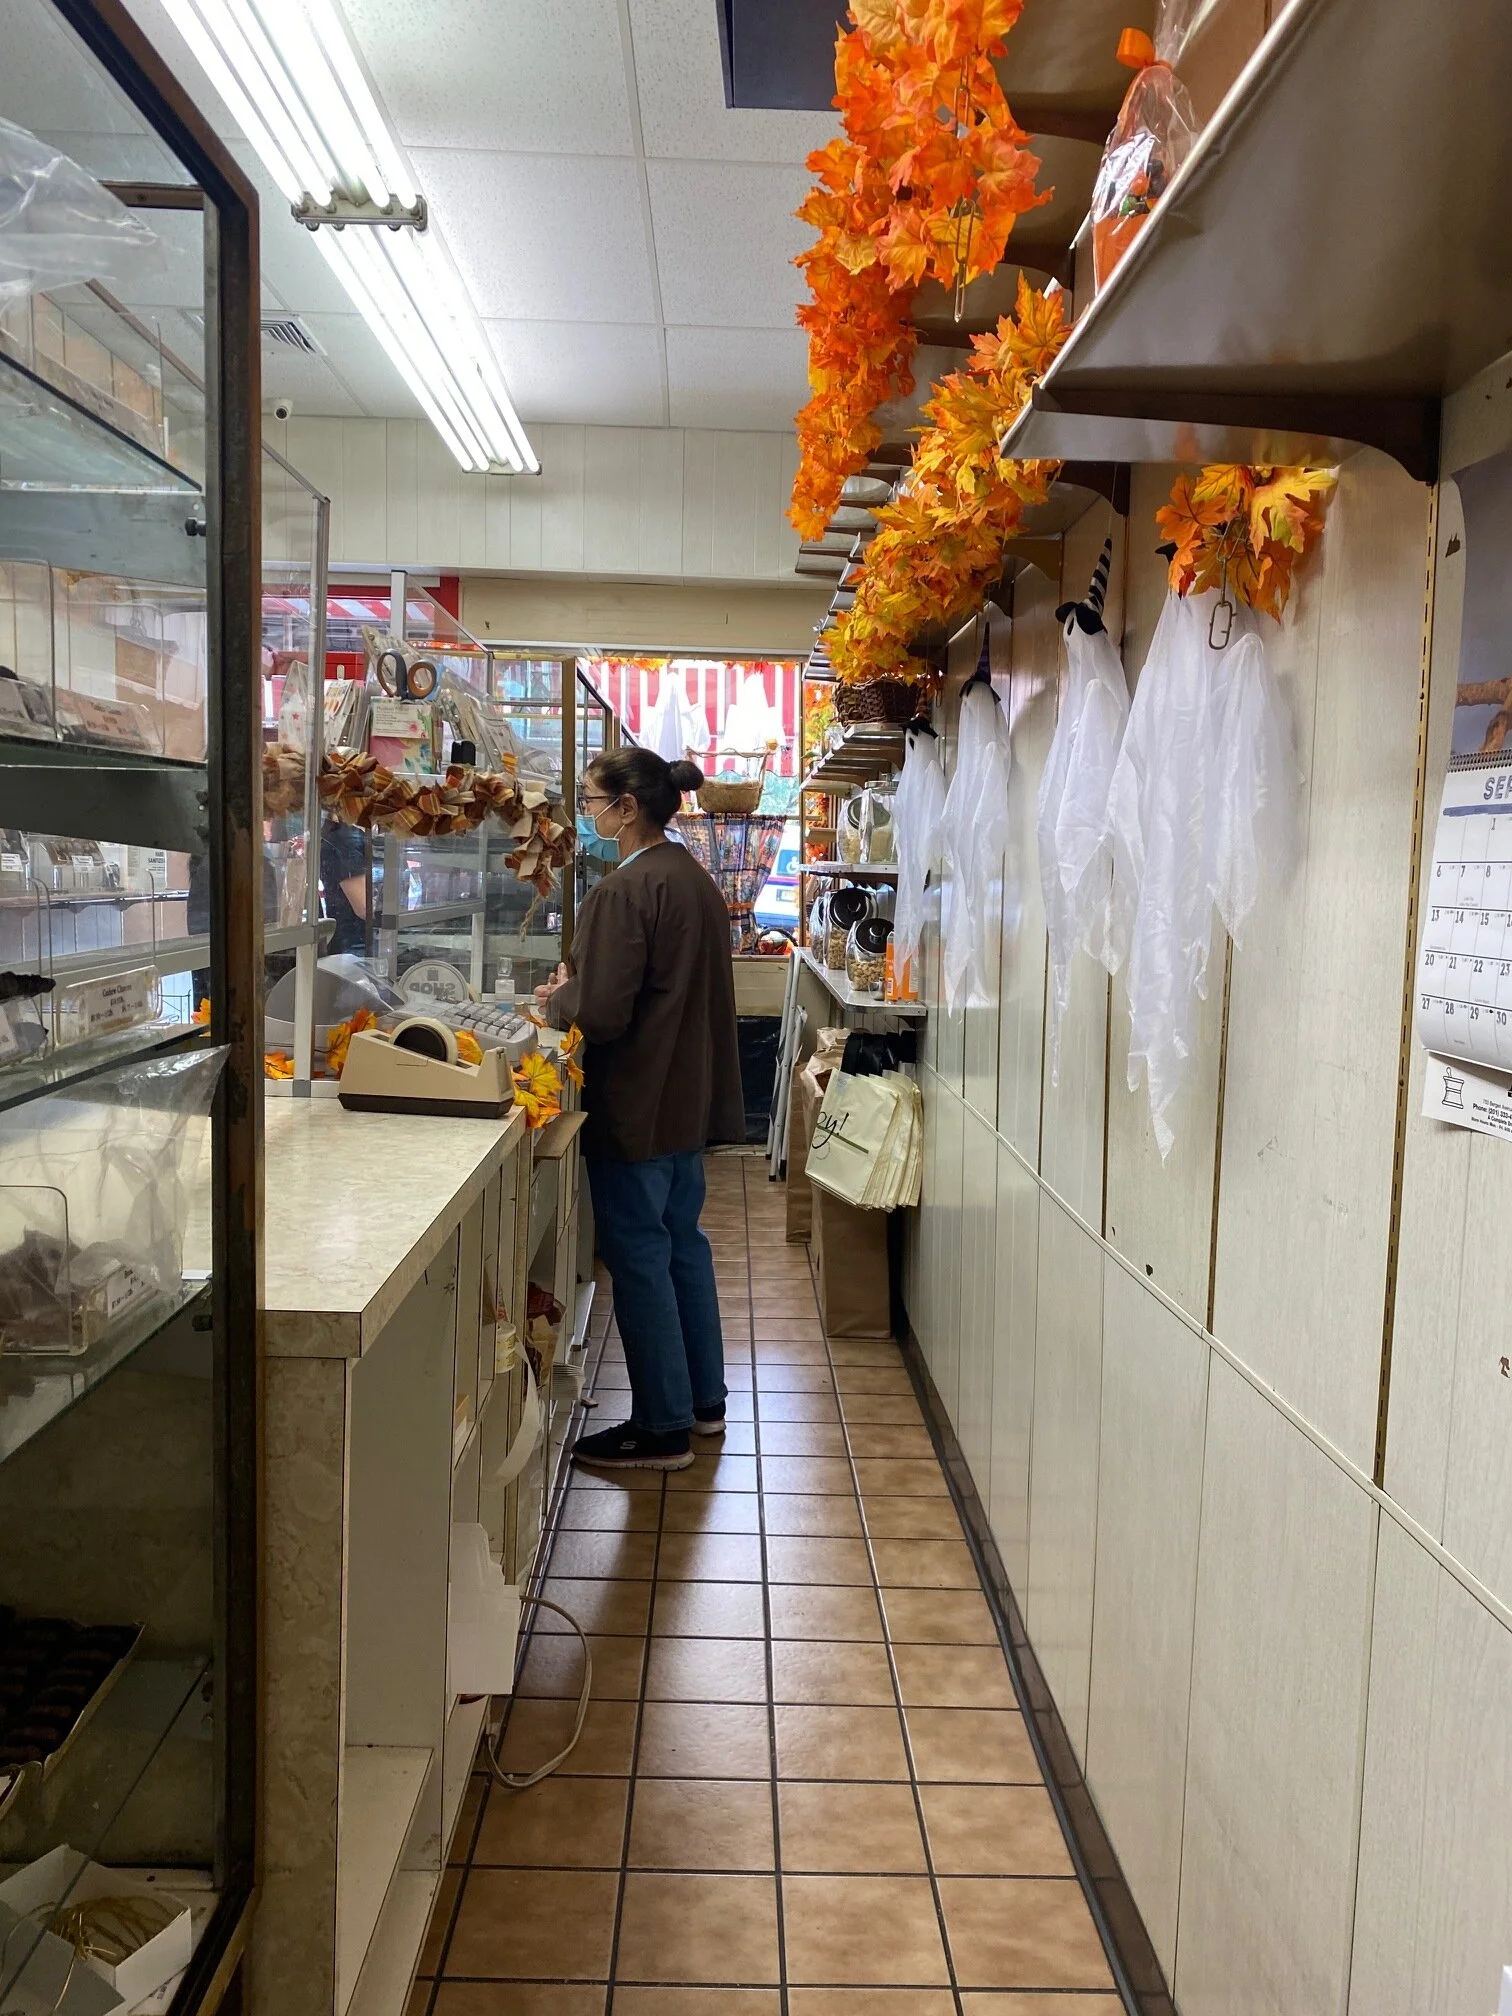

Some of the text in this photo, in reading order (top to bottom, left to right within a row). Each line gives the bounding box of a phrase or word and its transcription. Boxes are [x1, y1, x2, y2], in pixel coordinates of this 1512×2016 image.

[1436, 865, 1491, 878] 6 7 8
[1431, 909, 1440, 922] 13
[1455, 911, 1464, 924] 14
[1480, 912, 1489, 926] 15
[1425, 953, 1510, 976] 20 21 22 23
[1422, 997, 1507, 1026] 27 28 29 30
